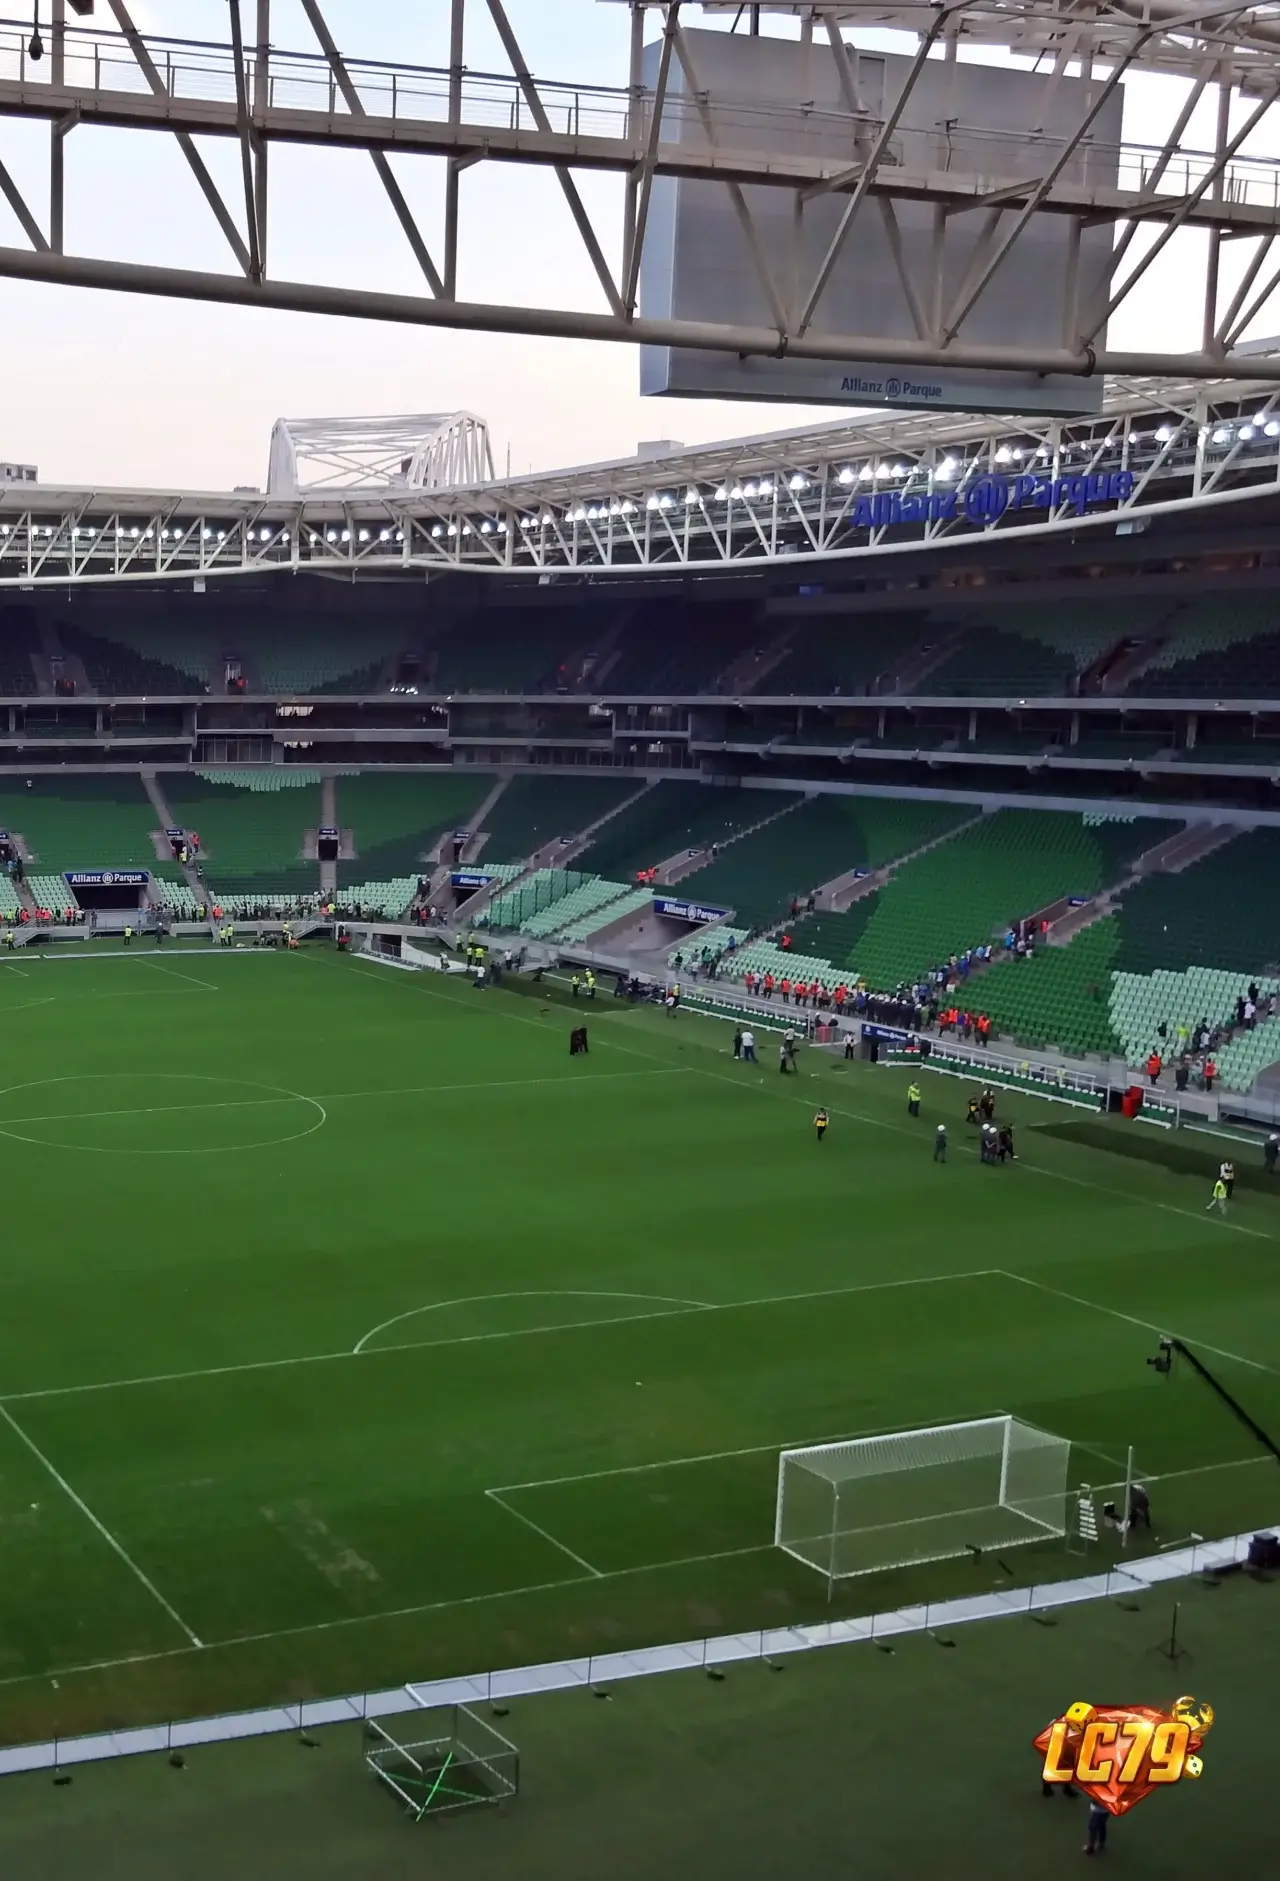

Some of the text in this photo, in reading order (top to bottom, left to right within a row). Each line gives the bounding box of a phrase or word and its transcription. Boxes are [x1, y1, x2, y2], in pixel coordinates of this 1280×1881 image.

[841, 378, 942, 398] Allianz Parque
[849, 471, 1134, 527] Allianz Parque
[71, 873, 142, 883] Allianz Parque
[663, 902, 687, 916] Allianz
